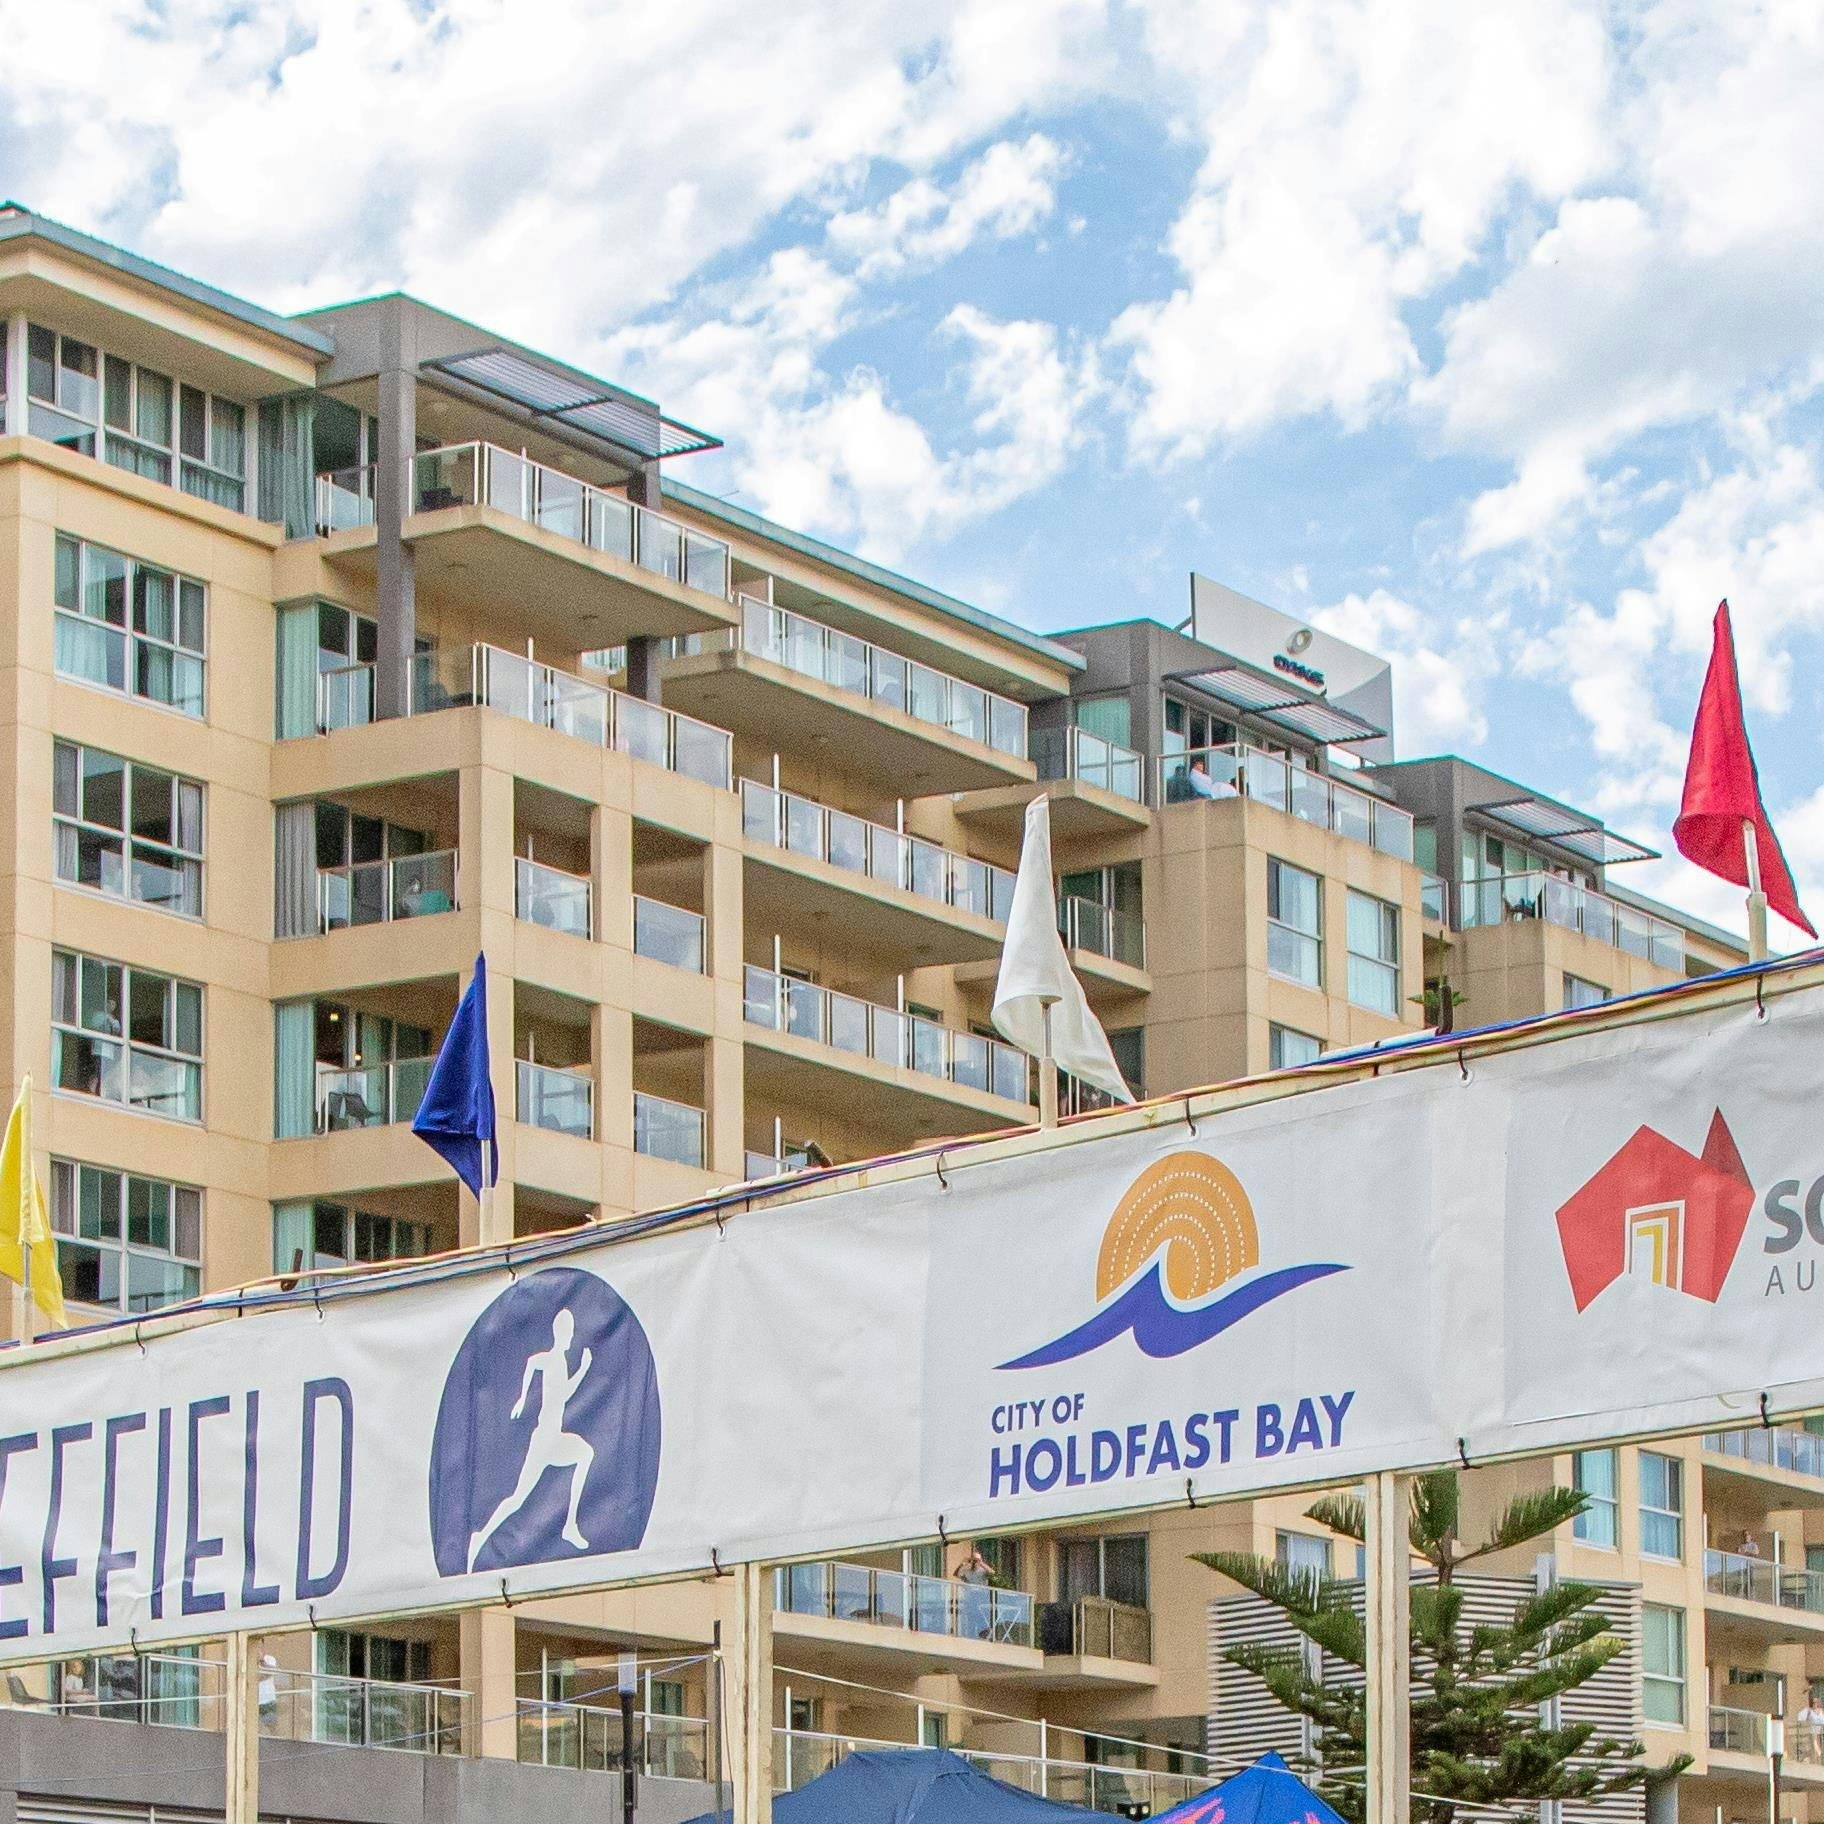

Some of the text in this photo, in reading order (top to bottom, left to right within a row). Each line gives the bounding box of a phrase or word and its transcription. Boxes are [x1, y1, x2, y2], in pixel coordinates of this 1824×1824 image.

[989, 1391, 1354, 1499] HOLDFAST BAY
[991, 1393, 1085, 1432] CITY OF
